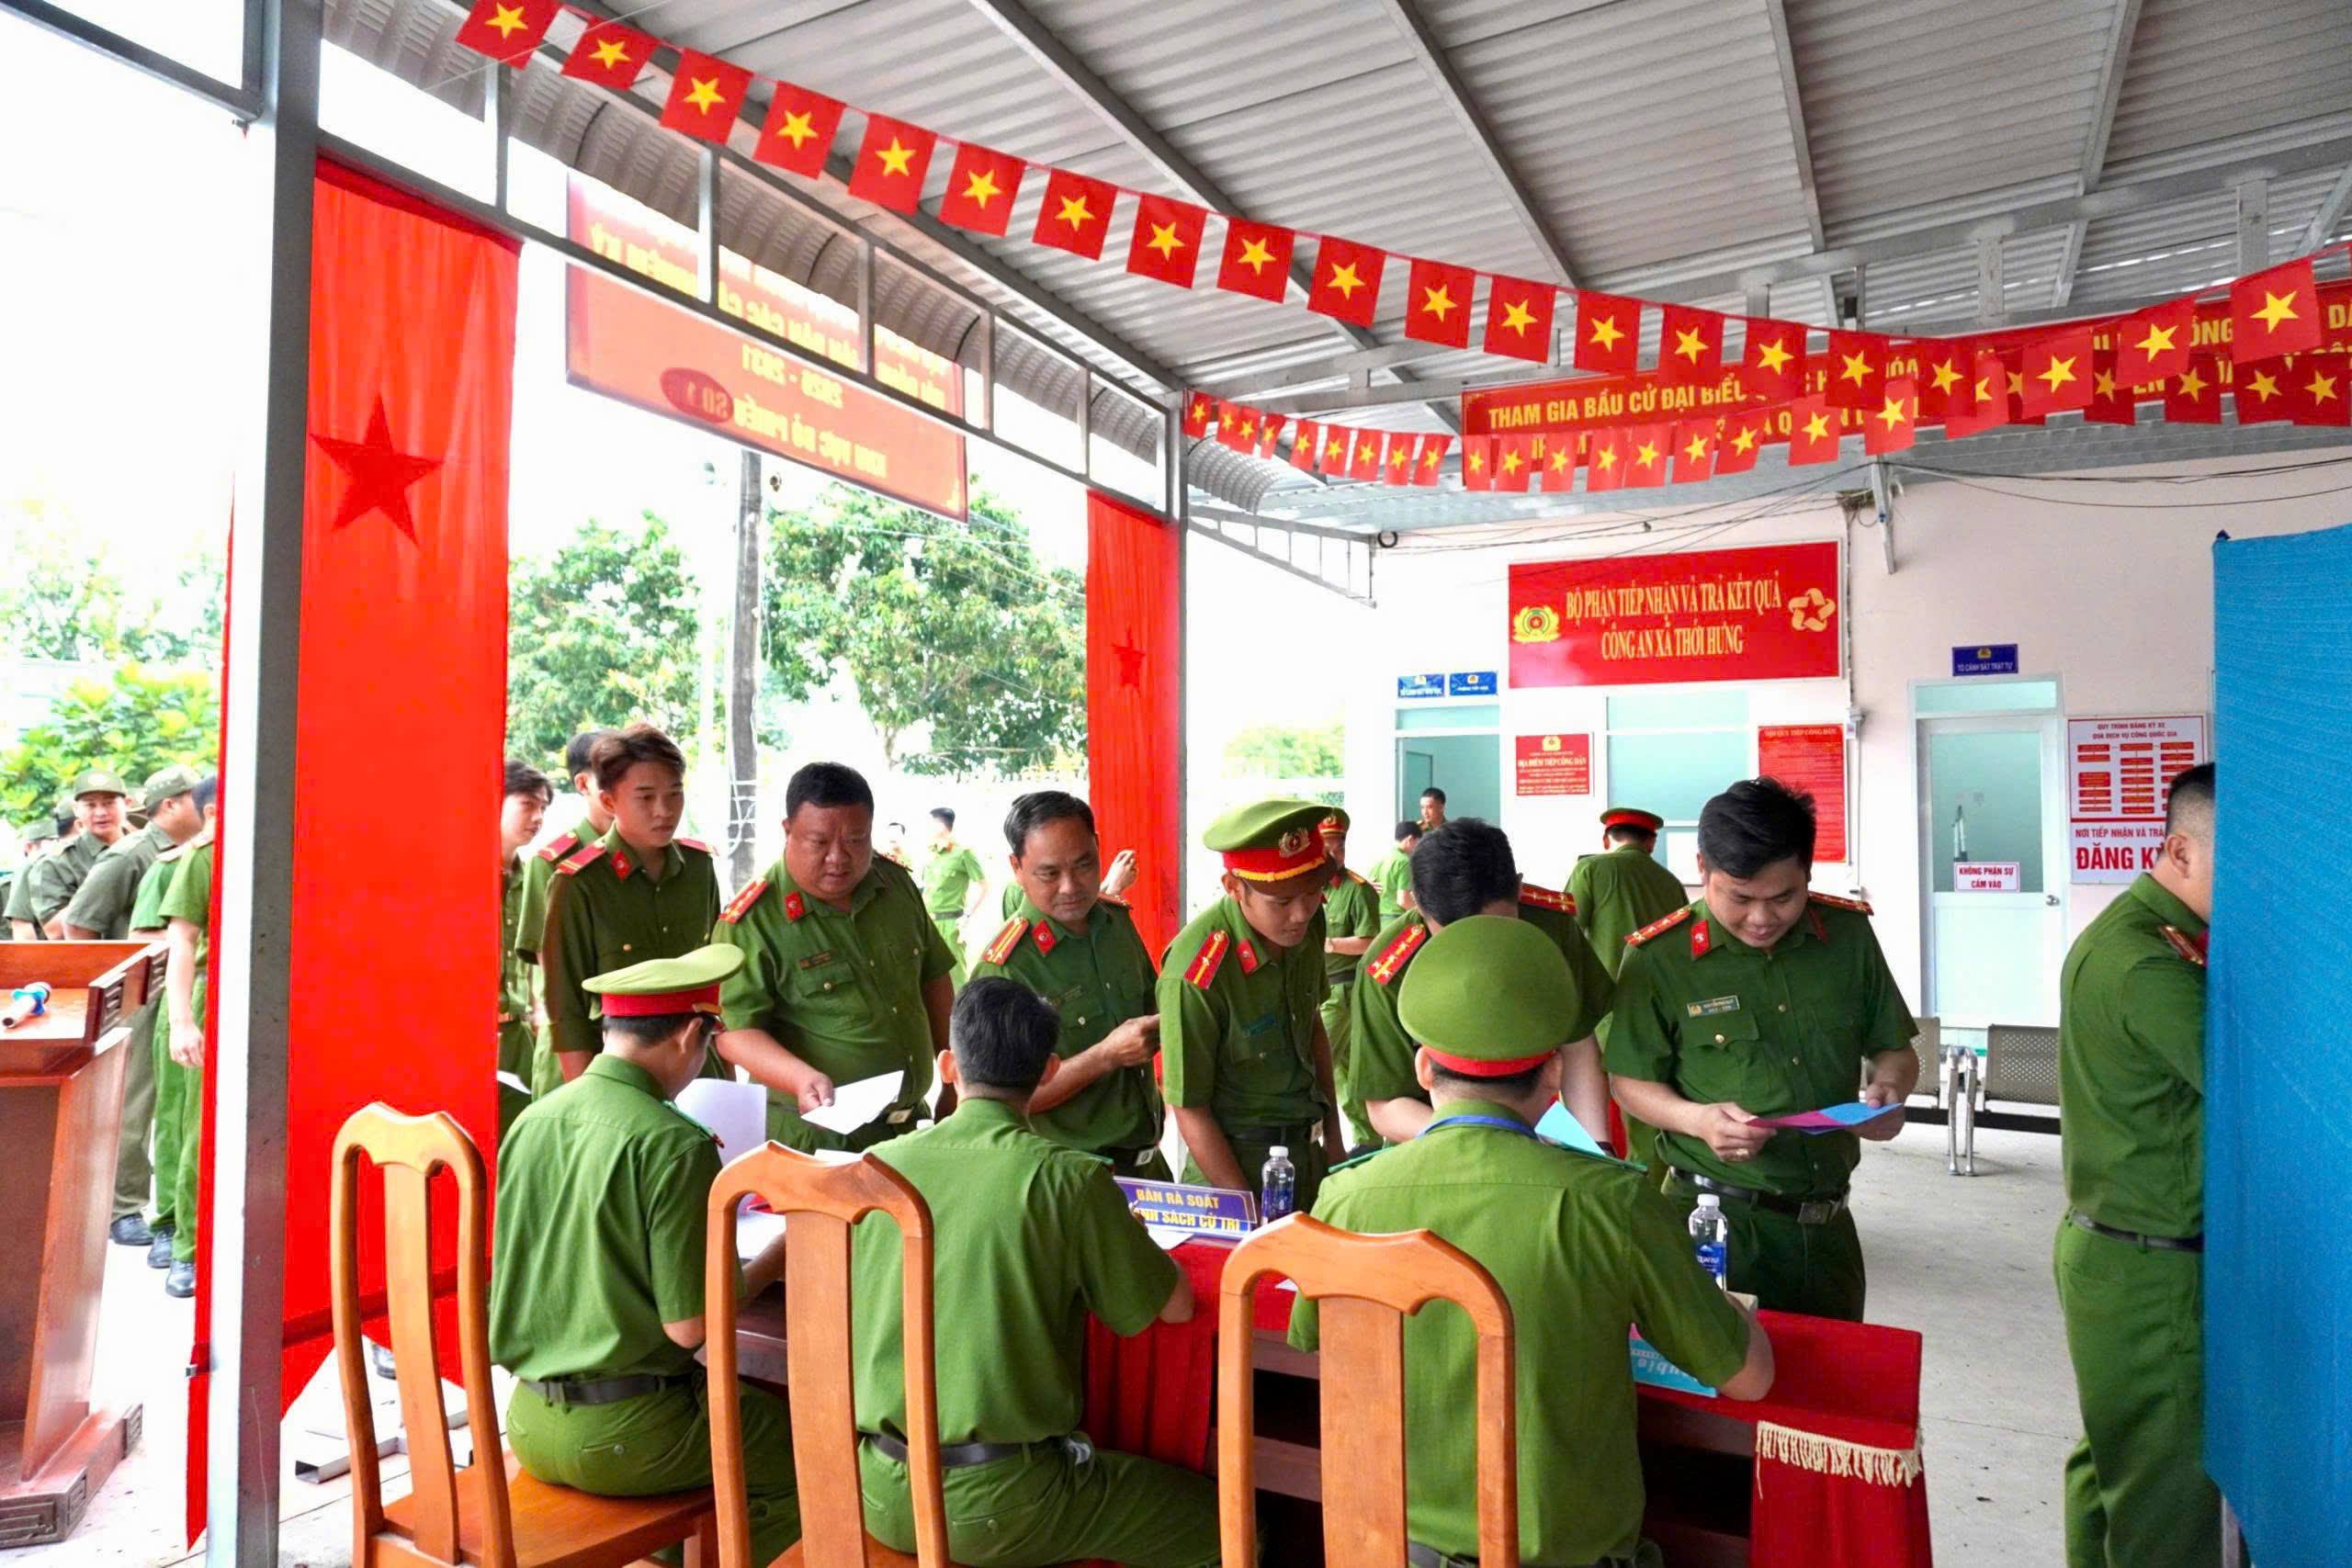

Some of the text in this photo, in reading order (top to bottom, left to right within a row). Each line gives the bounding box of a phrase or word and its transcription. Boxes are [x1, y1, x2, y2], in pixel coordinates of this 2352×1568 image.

[1487, 403, 1542, 429] THAM
[1546, 400, 1579, 423] GIA
[1584, 388, 1624, 419] BẦU
[1629, 382, 1657, 412] CỬ
[1661, 384, 1695, 413] ĐẠI
[1566, 587, 1583, 626] BỘ
[1585, 586, 1616, 626] PHẬN
[1618, 579, 1645, 617] TIẾP
[1645, 581, 1680, 623] NHẬN
[1700, 574, 1725, 613] TRẢ
[1726, 573, 1753, 611] KẾT
[1754, 570, 1782, 616] QUẢ
[1601, 622, 1636, 660] CÔNG
[1637, 630, 1654, 659] AN
[1673, 618, 1706, 657] THỚI
[1706, 620, 1744, 655] HƯNG
[2131, 730, 2148, 739] CÔNG
[2075, 828, 2090, 838] NƠI
[2091, 826, 2109, 838] TIẾP
[2110, 826, 2134, 840] NHẬN
[2135, 827, 2148, 838] VÀ
[2075, 842, 2134, 870] ĐĂNG
[1959, 866, 1983, 875] KHÔNG
[1136, 1186, 1219, 1209] BÀN RÀ SOÁT
[1161, 1210, 1195, 1226] SÁCH
[1220, 1217, 1240, 1231] TRI
